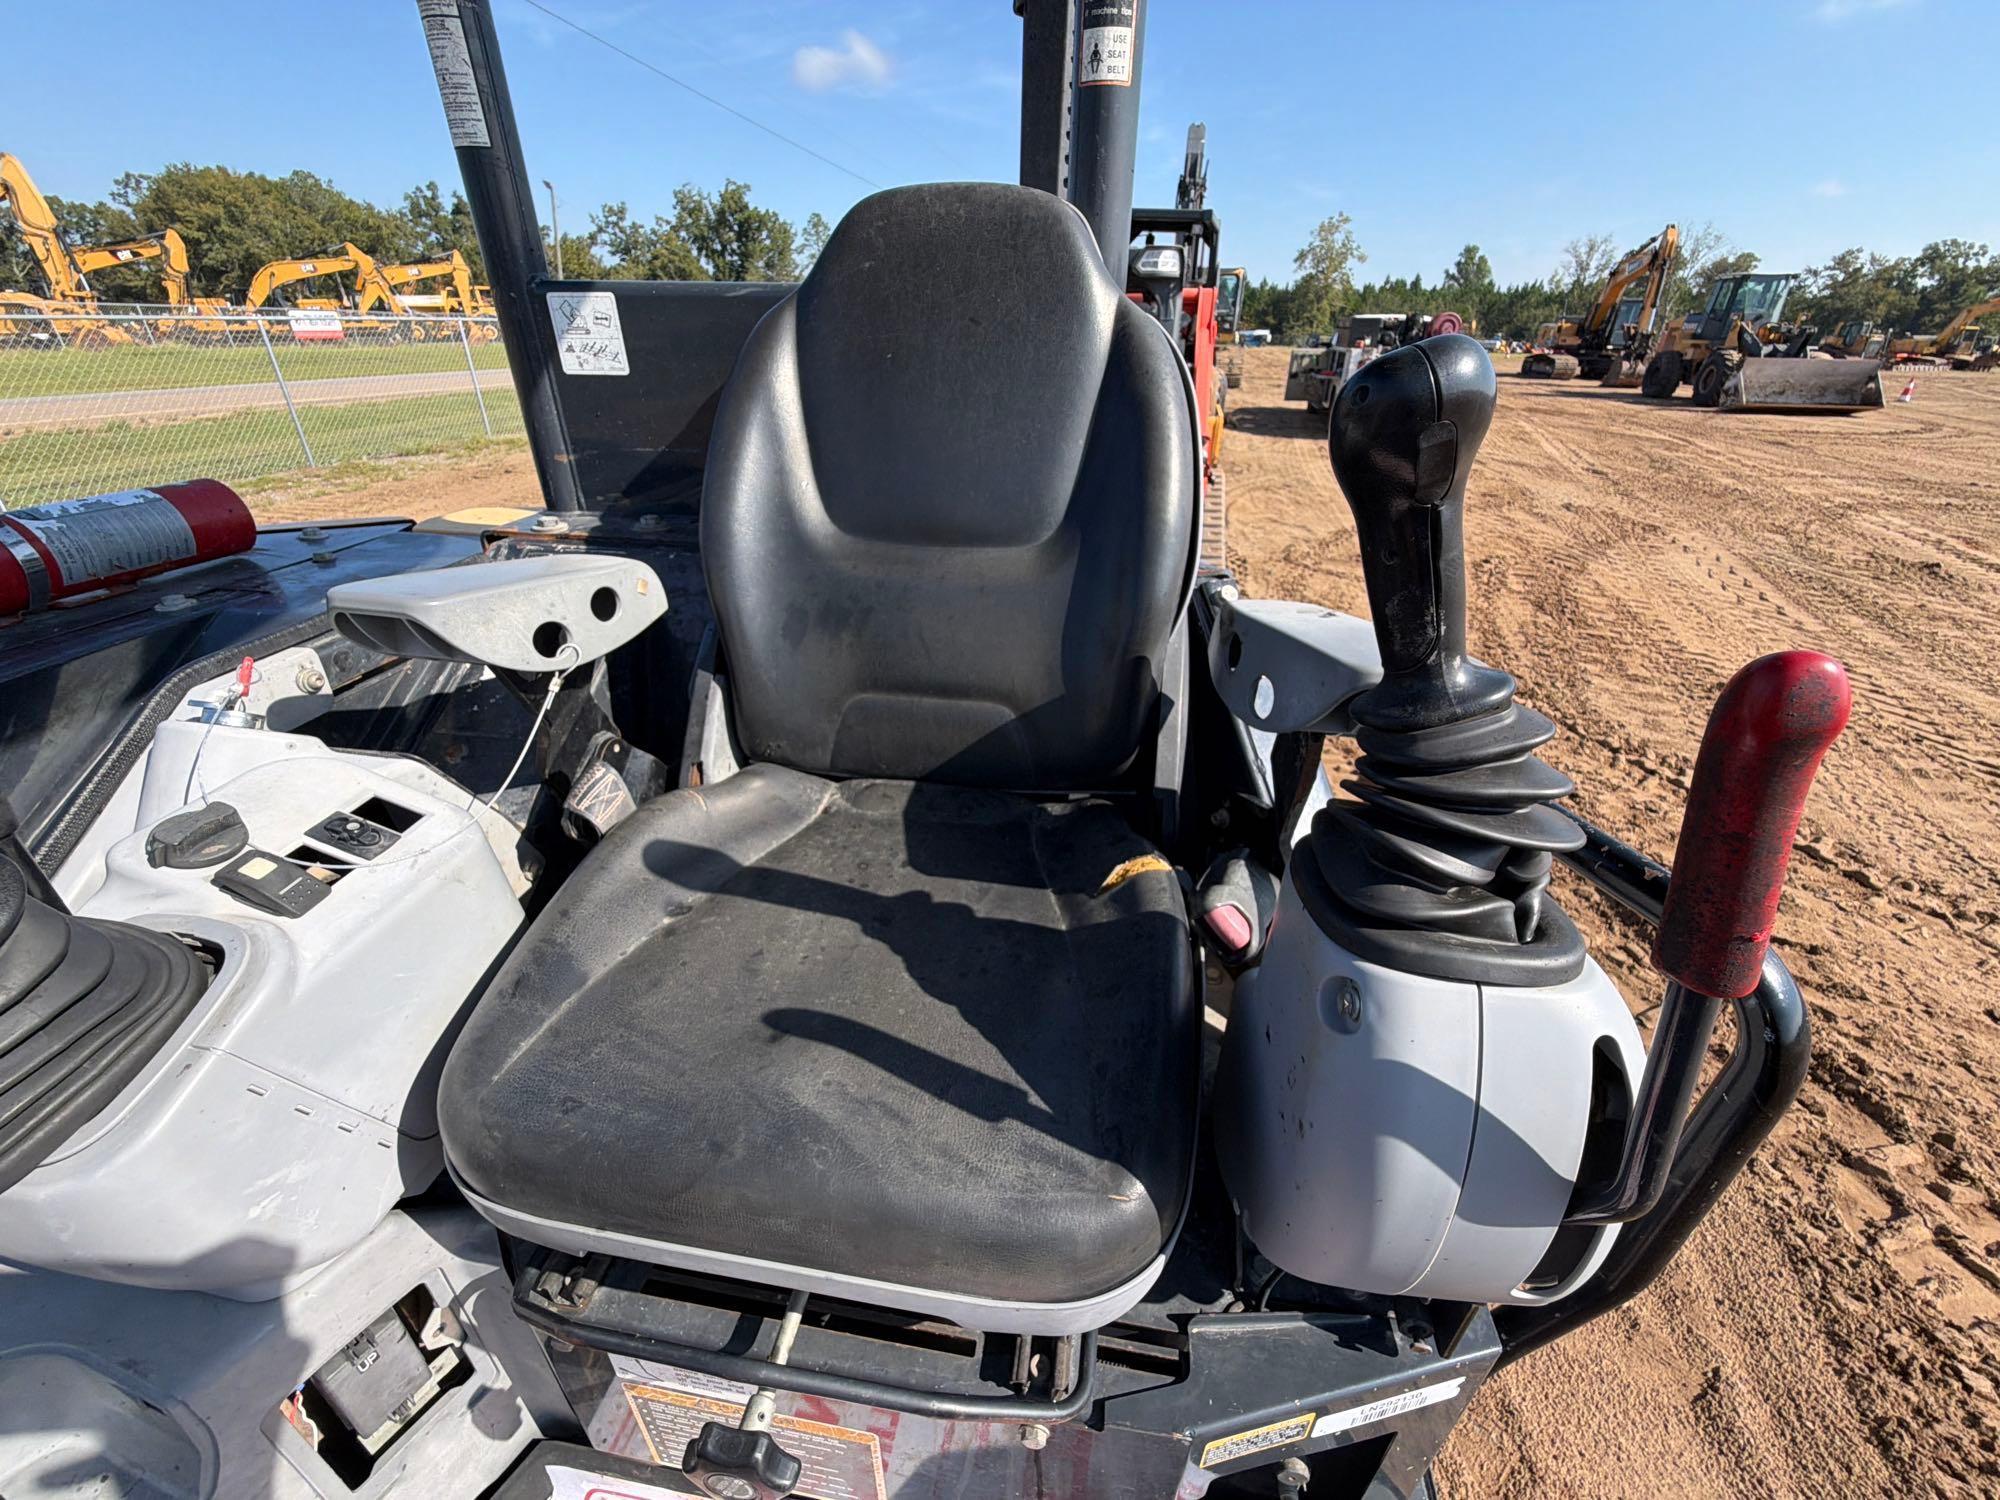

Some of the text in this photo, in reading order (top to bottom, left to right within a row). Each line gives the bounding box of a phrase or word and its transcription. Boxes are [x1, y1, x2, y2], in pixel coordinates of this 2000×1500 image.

[1091, 6, 1118, 16] machine
[1113, 34, 1128, 44] USE
[1107, 50, 1126, 59] SEAT
[1107, 66, 1125, 74] BELT
[117, 250, 133, 261] CAT
[357, 1352, 378, 1372] UP
